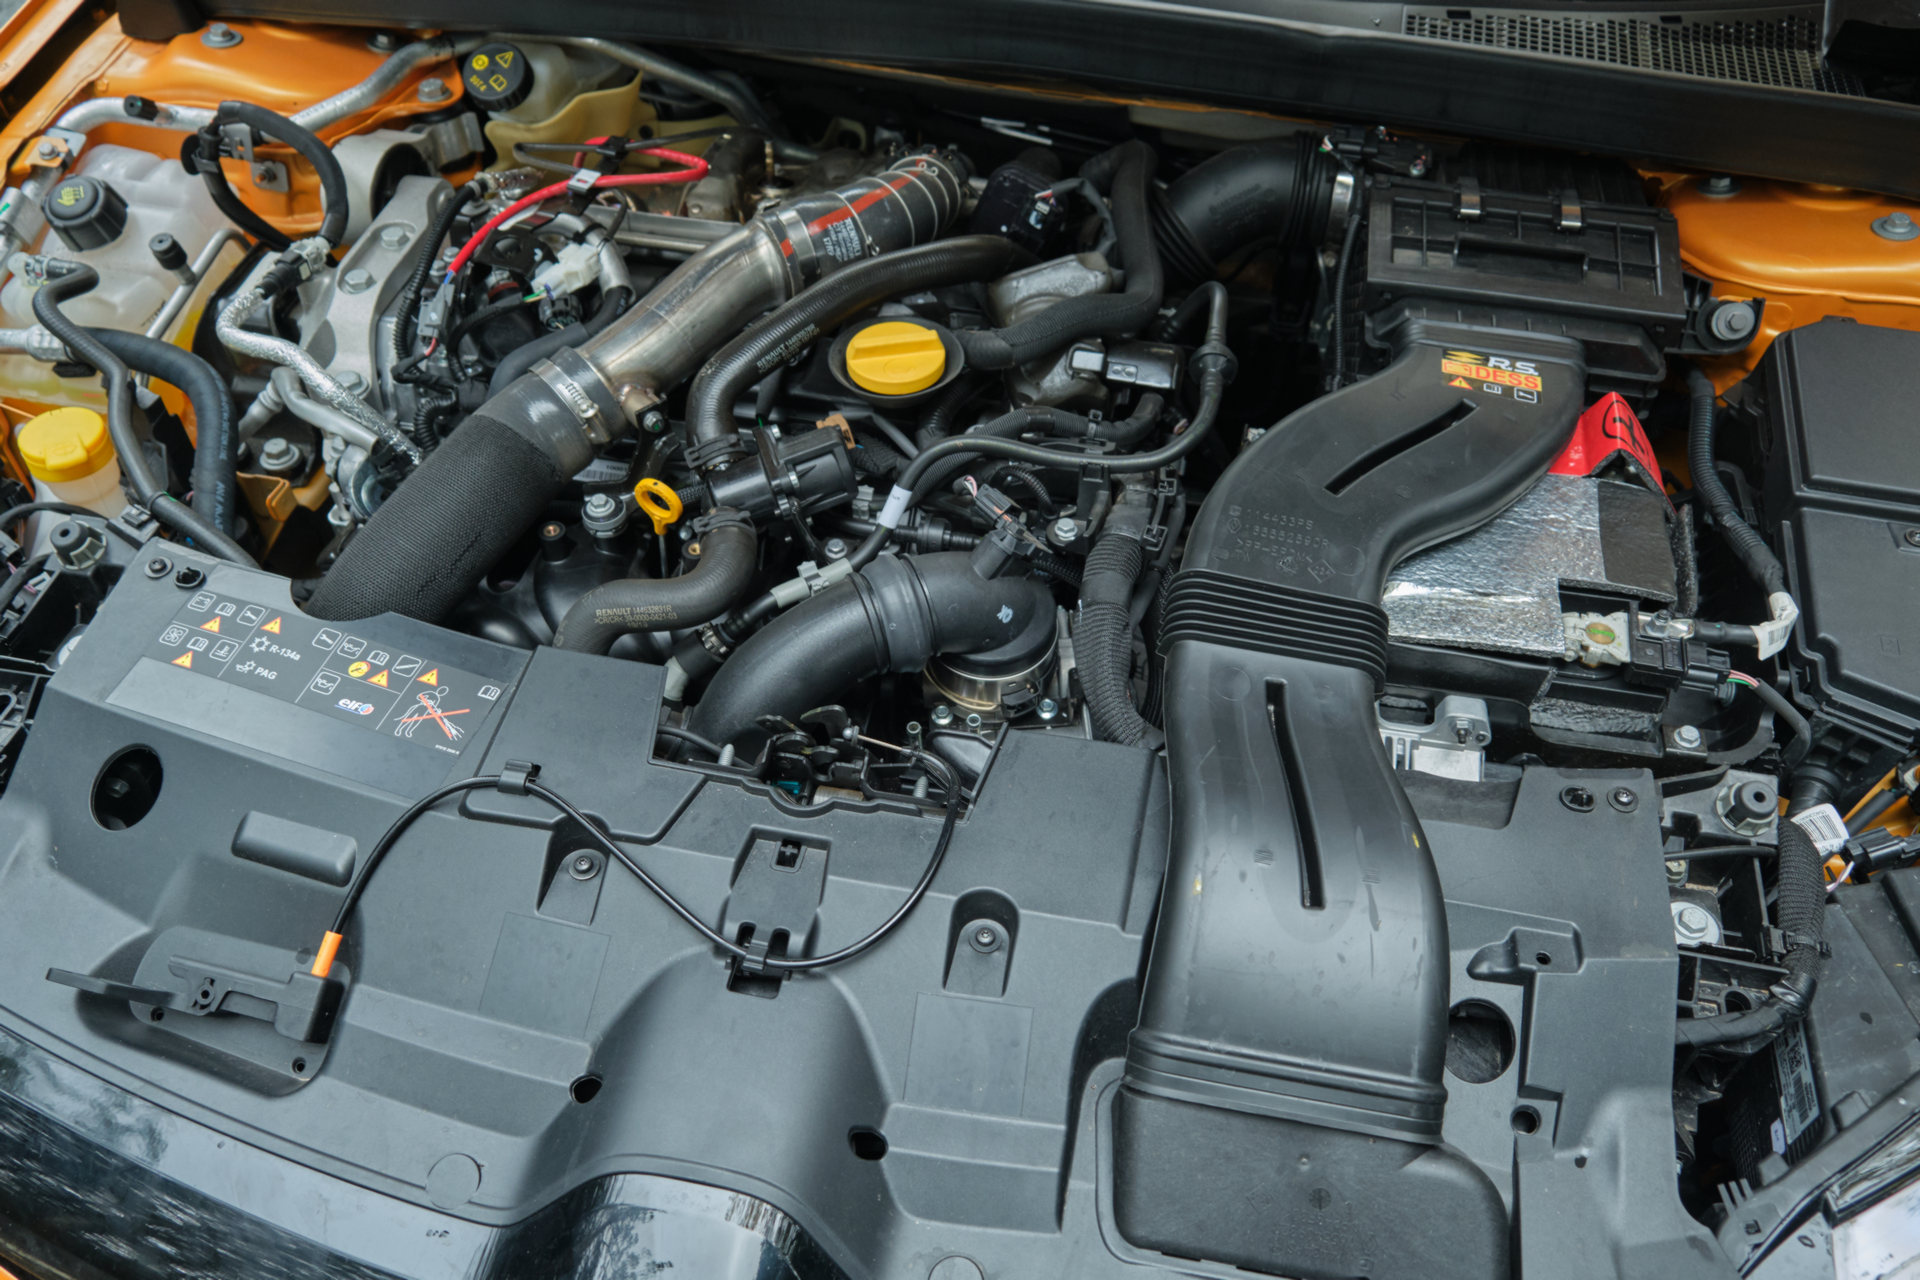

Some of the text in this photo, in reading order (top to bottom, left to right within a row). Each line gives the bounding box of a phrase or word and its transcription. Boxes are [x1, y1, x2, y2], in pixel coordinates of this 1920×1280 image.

[1475, 366, 1539, 390] DESS
[596, 607, 631, 617] RENAULT
[269, 644, 301, 661] R-134a
[254, 667, 278, 680] PAG
